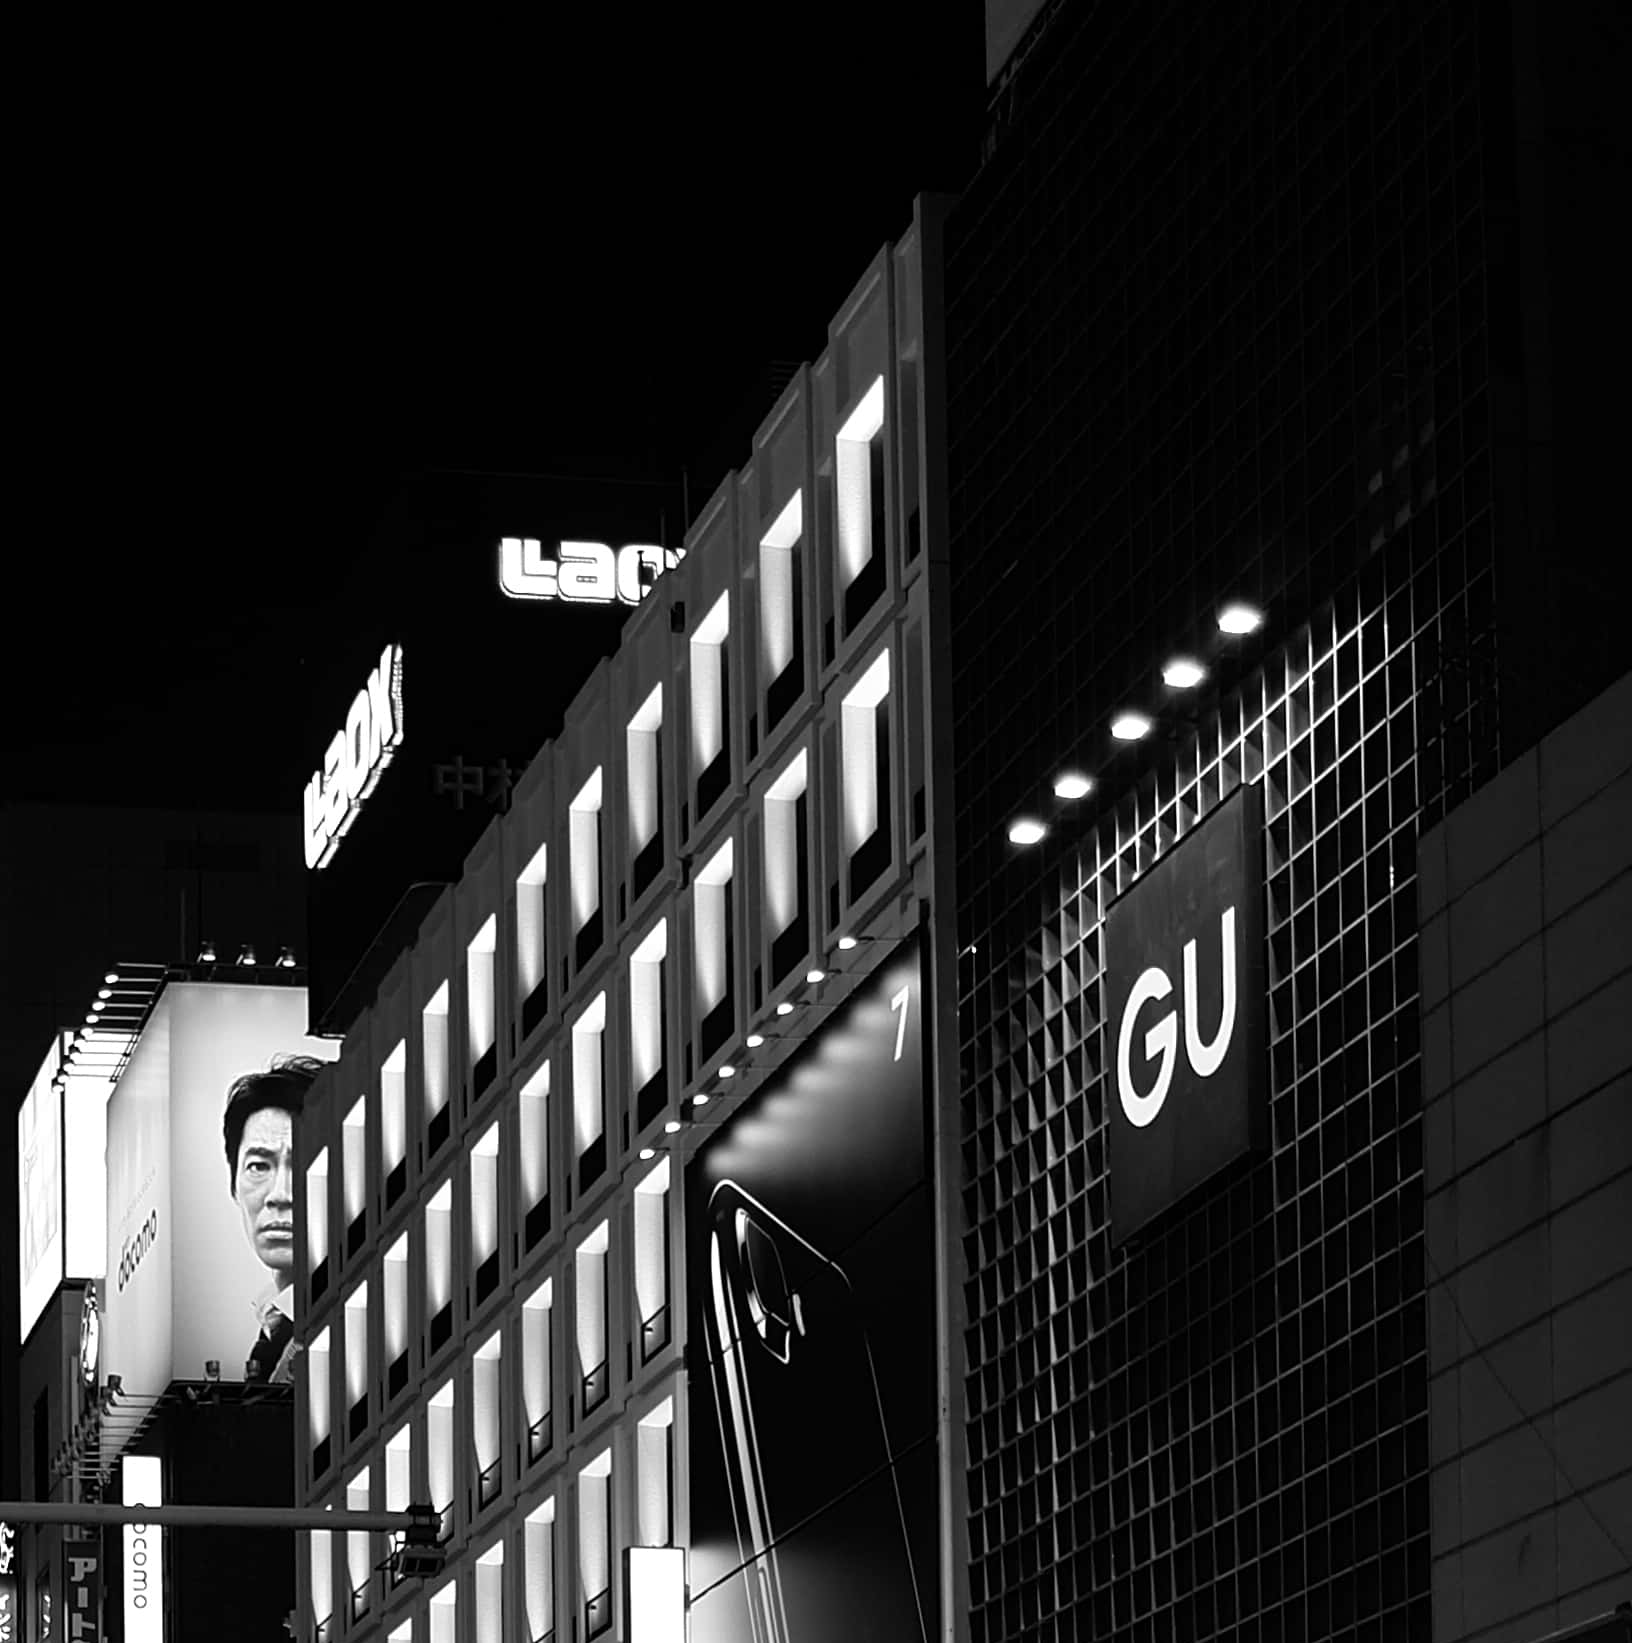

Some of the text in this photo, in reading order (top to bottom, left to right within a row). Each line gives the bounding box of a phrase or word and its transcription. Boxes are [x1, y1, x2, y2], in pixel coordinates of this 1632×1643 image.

[1117, 905, 1236, 1128] GU
[119, 1208, 157, 1293] docomo
[133, 1502, 148, 1609] ocomo
